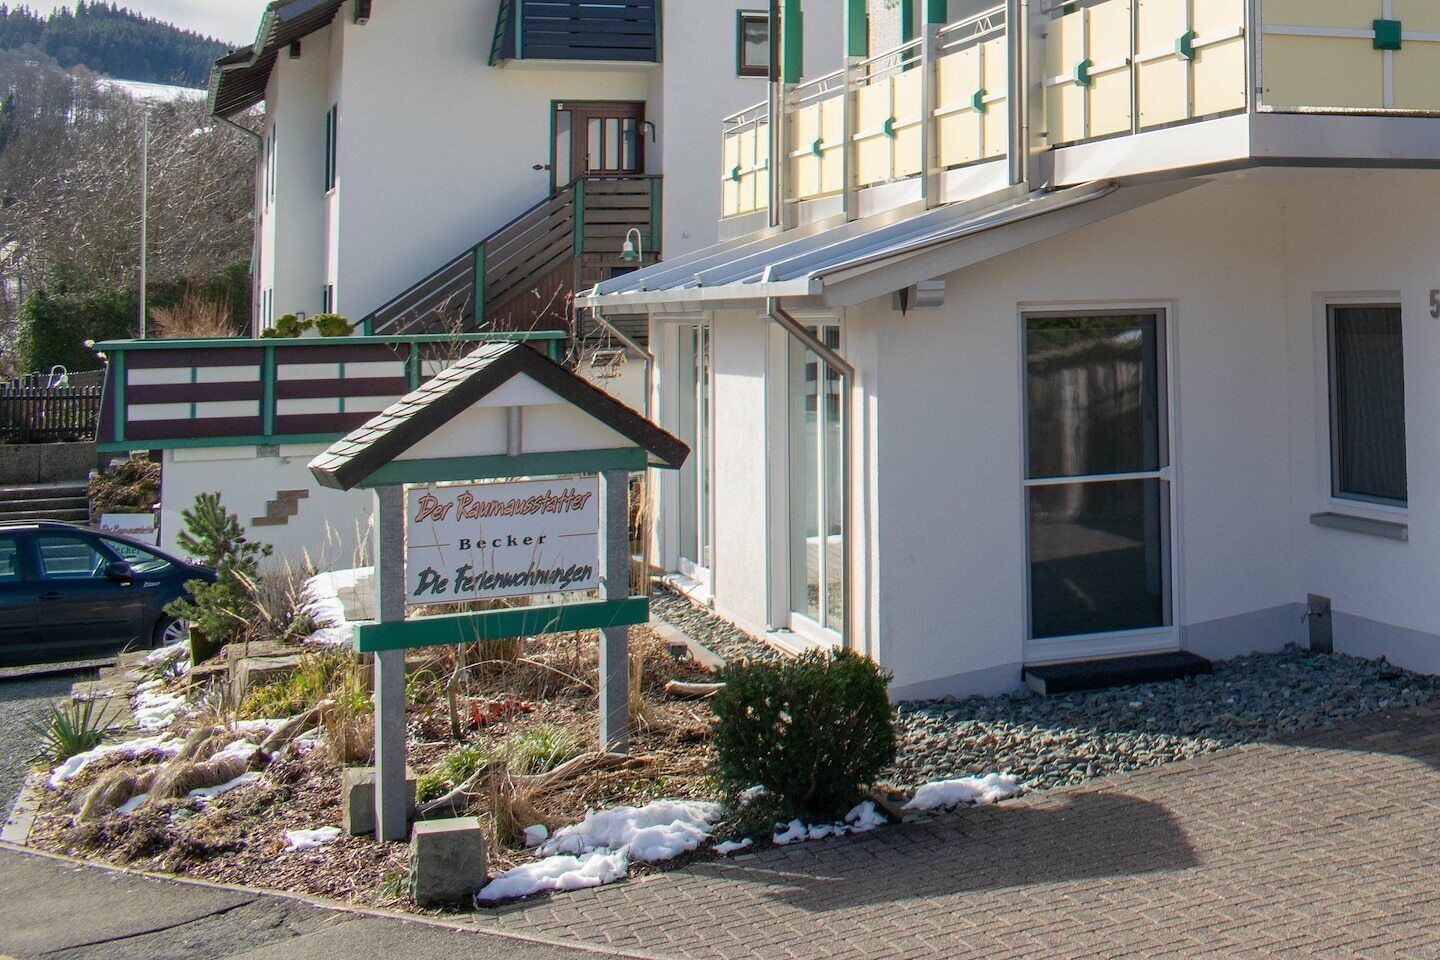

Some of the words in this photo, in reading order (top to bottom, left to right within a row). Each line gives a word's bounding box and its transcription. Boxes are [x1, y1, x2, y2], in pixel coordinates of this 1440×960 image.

[414, 492, 454, 522] Der
[456, 489, 592, 522] Raumausstatter
[459, 534, 547, 551] Becker
[413, 566, 449, 596] Die
[454, 561, 593, 594] Ferienwohnungen
